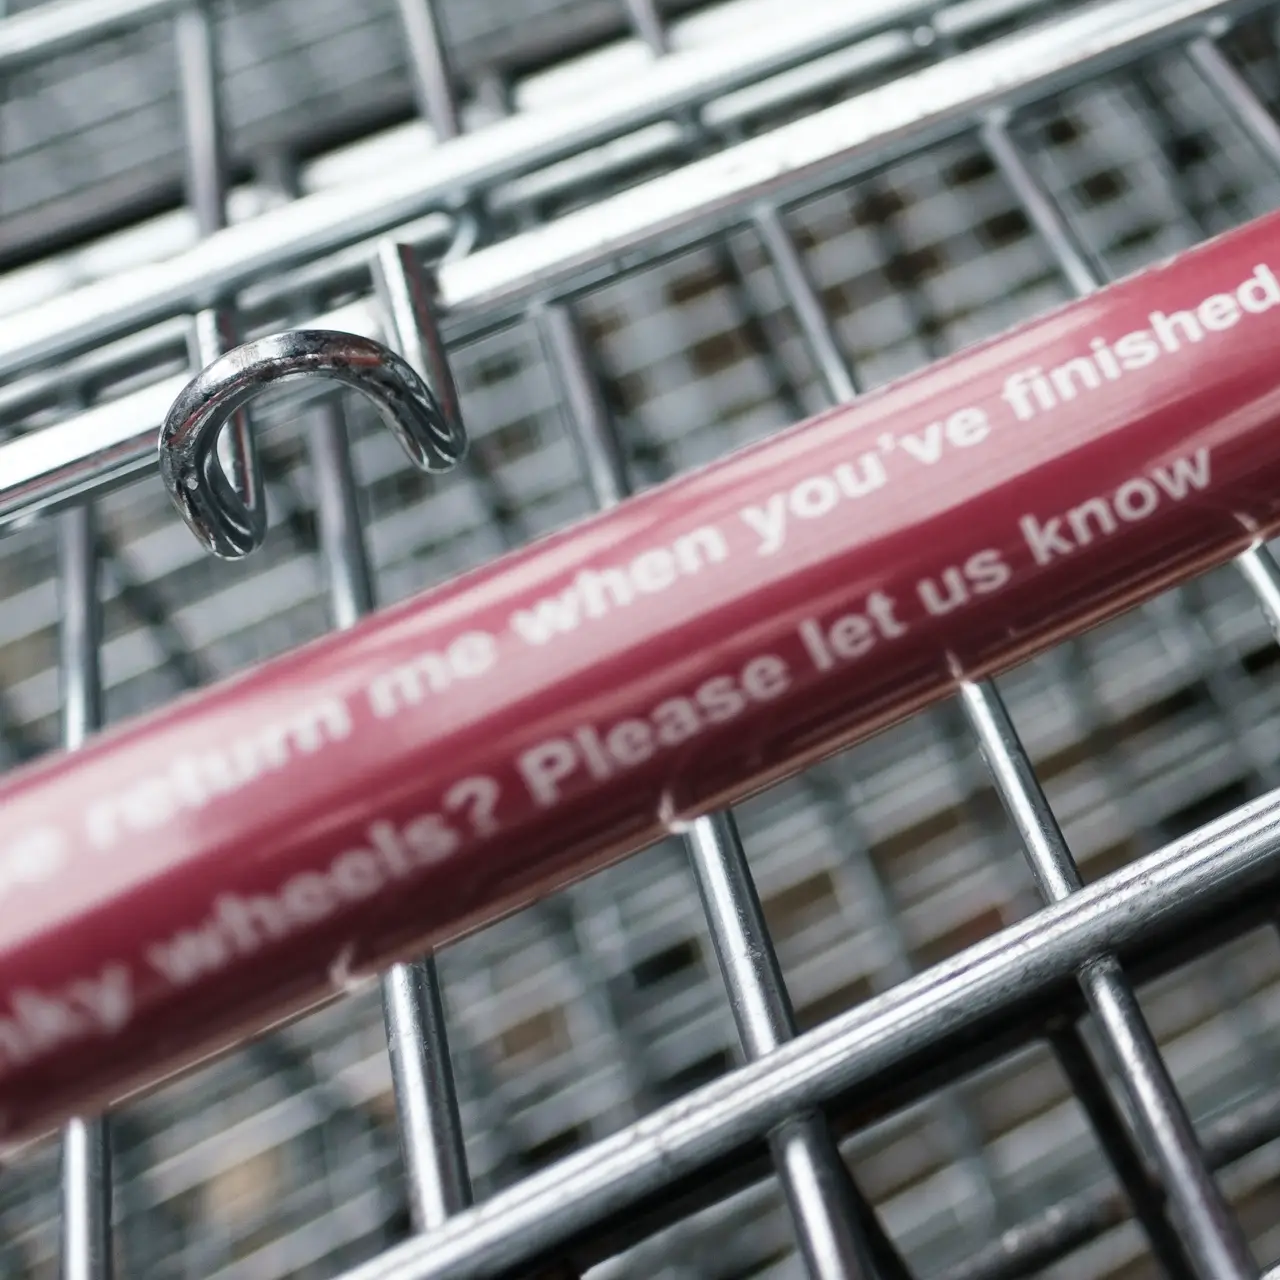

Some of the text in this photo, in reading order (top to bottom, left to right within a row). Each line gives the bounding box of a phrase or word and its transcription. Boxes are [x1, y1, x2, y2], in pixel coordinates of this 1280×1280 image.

[147, 776, 499, 985] wheels?
[518, 655, 793, 807] Please
[798, 591, 906, 672] let
[916, 545, 1012, 618] us
[1020, 448, 1213, 567] know
[369, 630, 498, 718] me
[508, 524, 729, 646] when
[739, 403, 993, 556] you've
